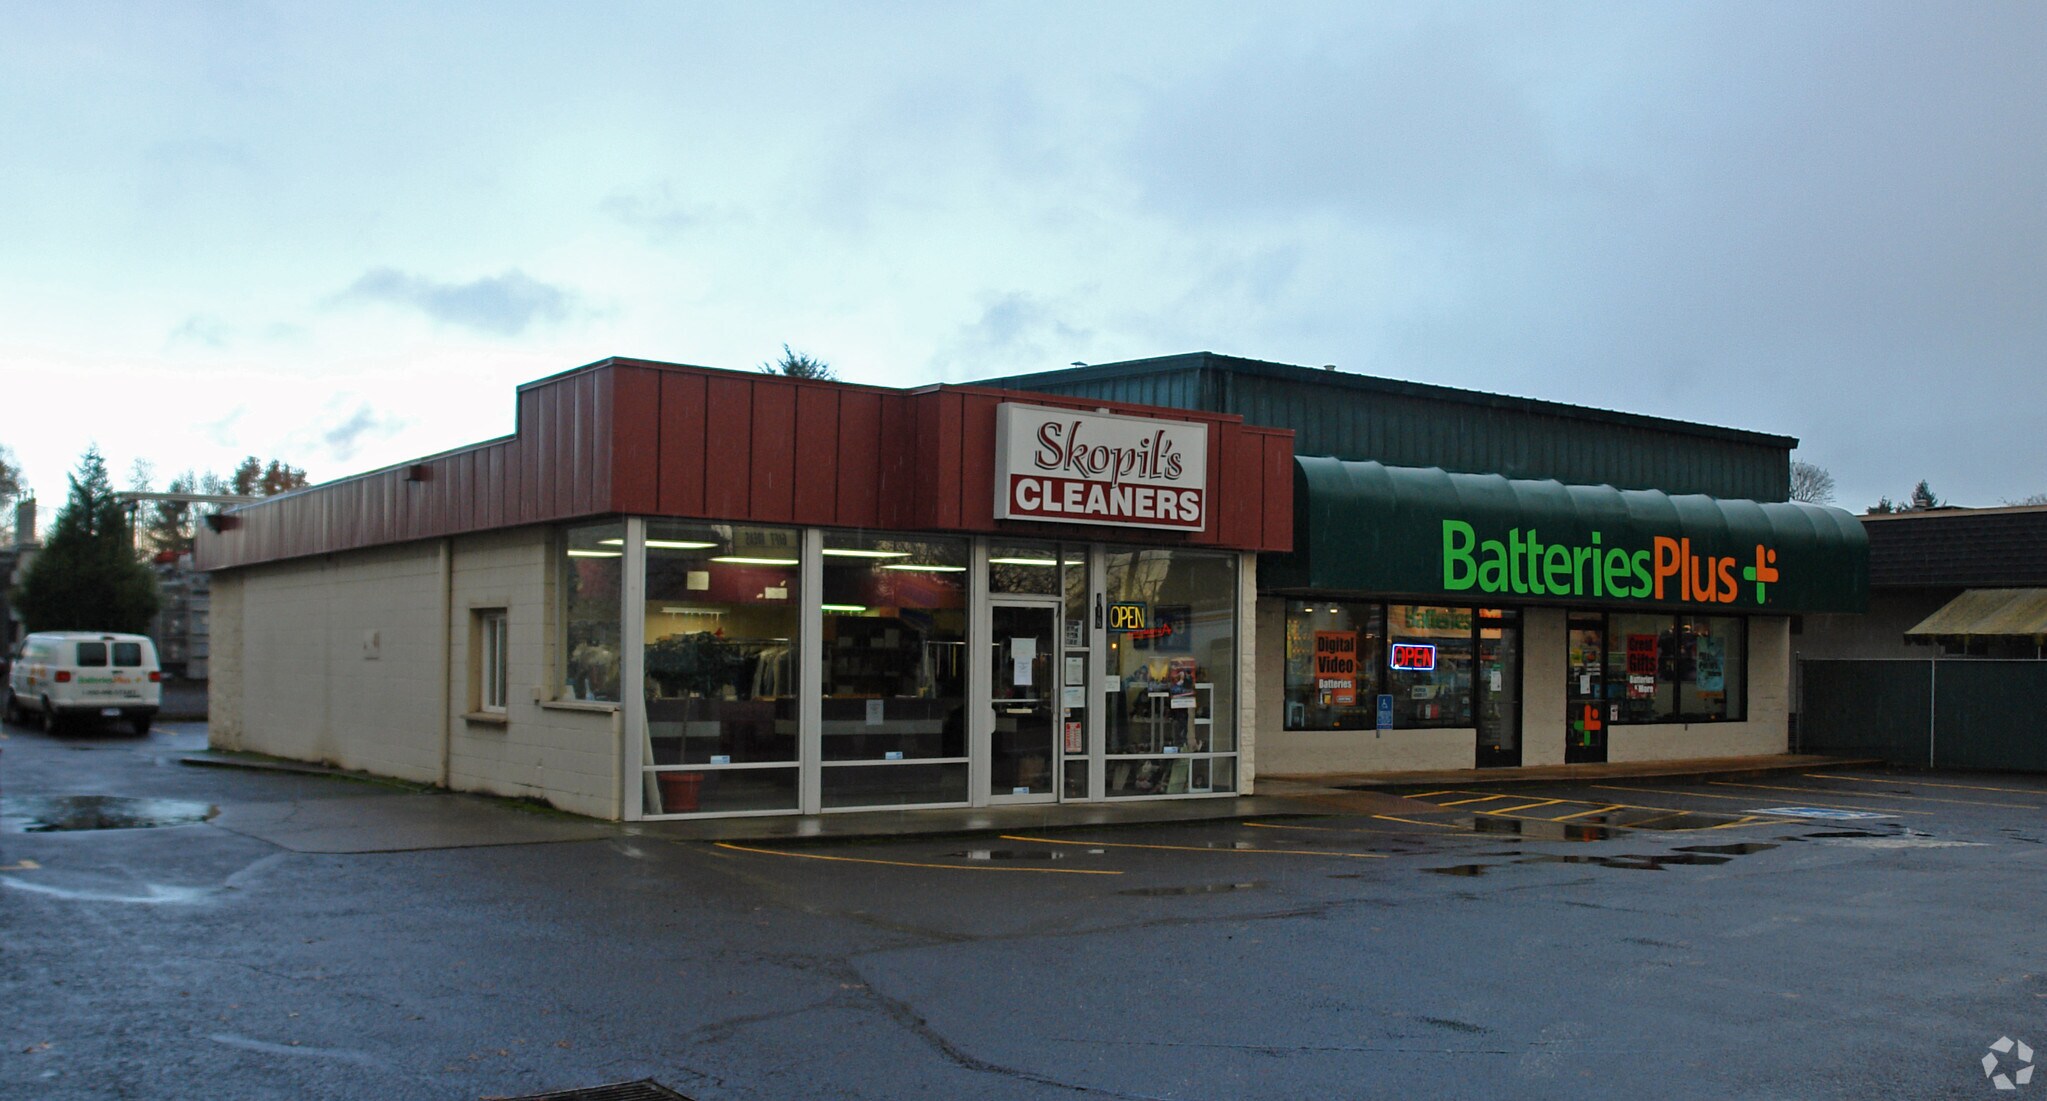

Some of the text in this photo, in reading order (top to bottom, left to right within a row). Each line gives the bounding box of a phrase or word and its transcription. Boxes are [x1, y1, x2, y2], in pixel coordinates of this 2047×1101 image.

[1035, 421, 1183, 488] Skopil's
[1015, 478, 1200, 521] CLEANERS
[1110, 605, 1144, 629] OPEN
[1318, 637, 1354, 654] Digital
[1318, 656, 1353, 673] Video
[1394, 646, 1432, 667] OPEN
[1630, 653, 1655, 672] Gifts
[1318, 678, 1352, 689] Batteries
